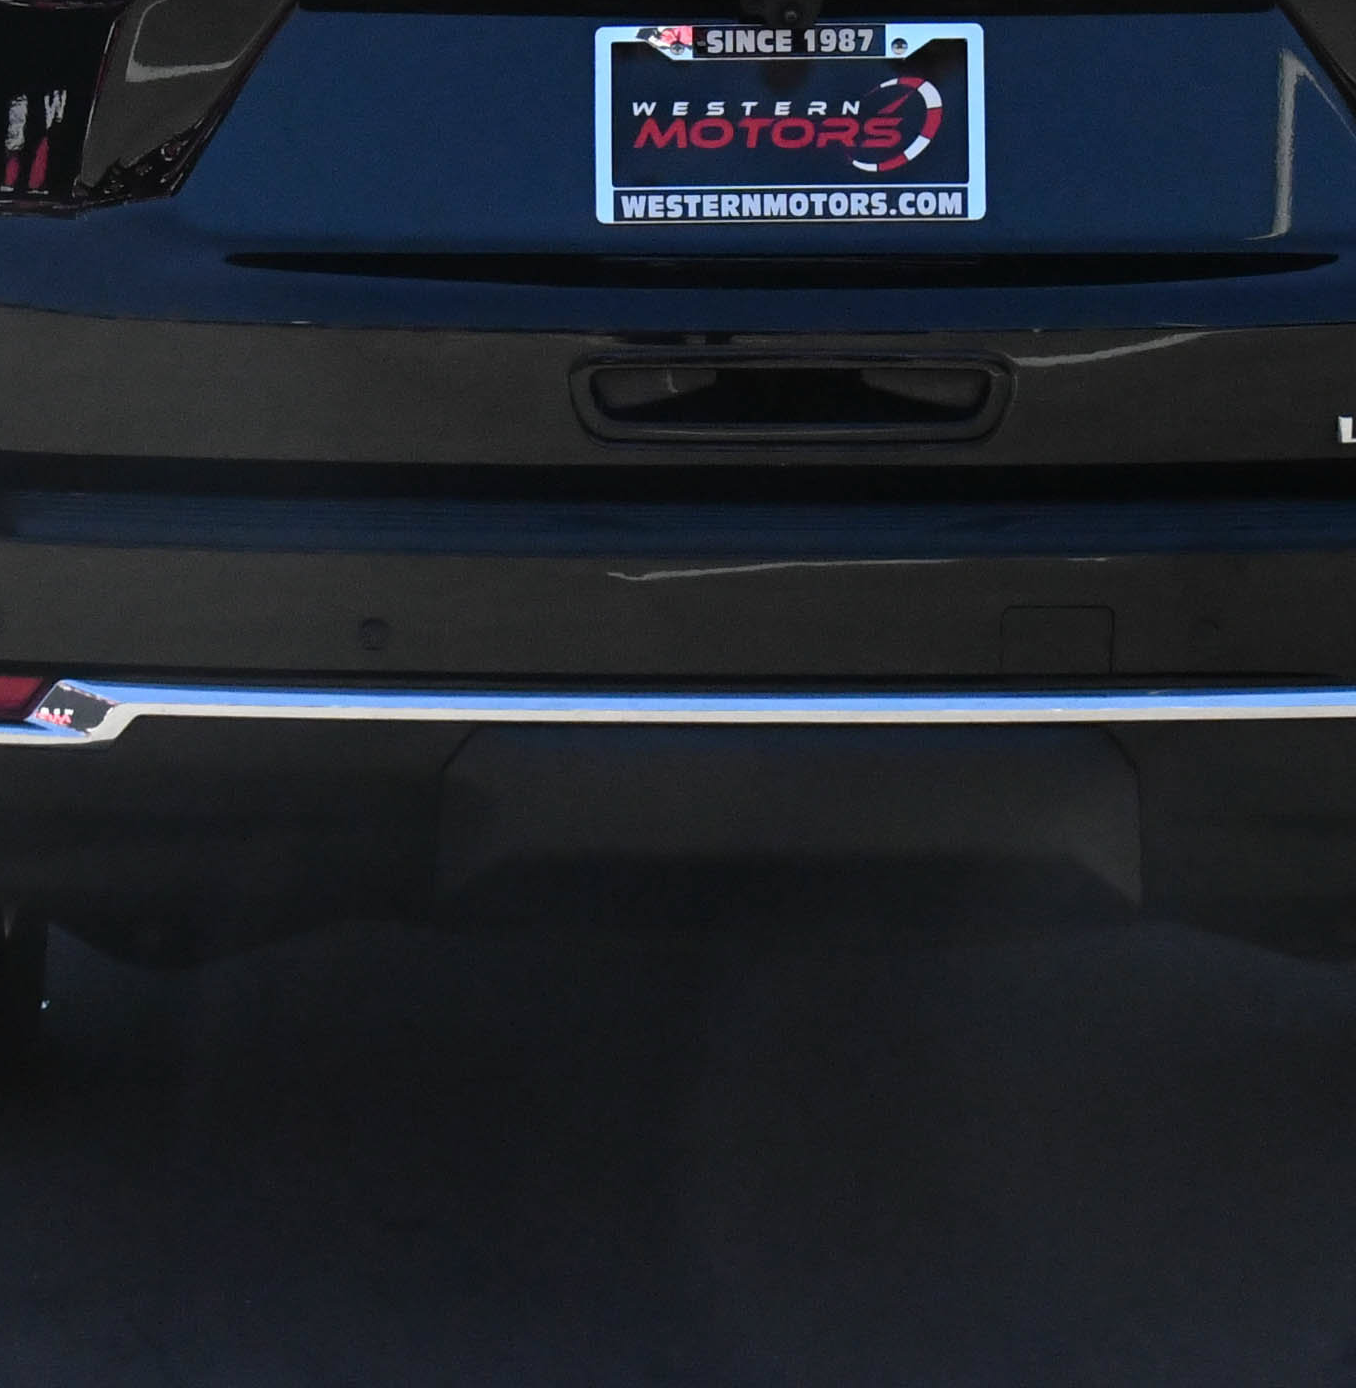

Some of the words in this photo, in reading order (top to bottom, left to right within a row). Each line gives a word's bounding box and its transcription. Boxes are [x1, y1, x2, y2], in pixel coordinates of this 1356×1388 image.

[706, 29, 793, 54] SINCE
[803, 28, 874, 53] 1987
[632, 100, 862, 117] WESTERN
[633, 117, 904, 149] MOTORS
[620, 191, 963, 219] WESTERNMOTORS.COM
